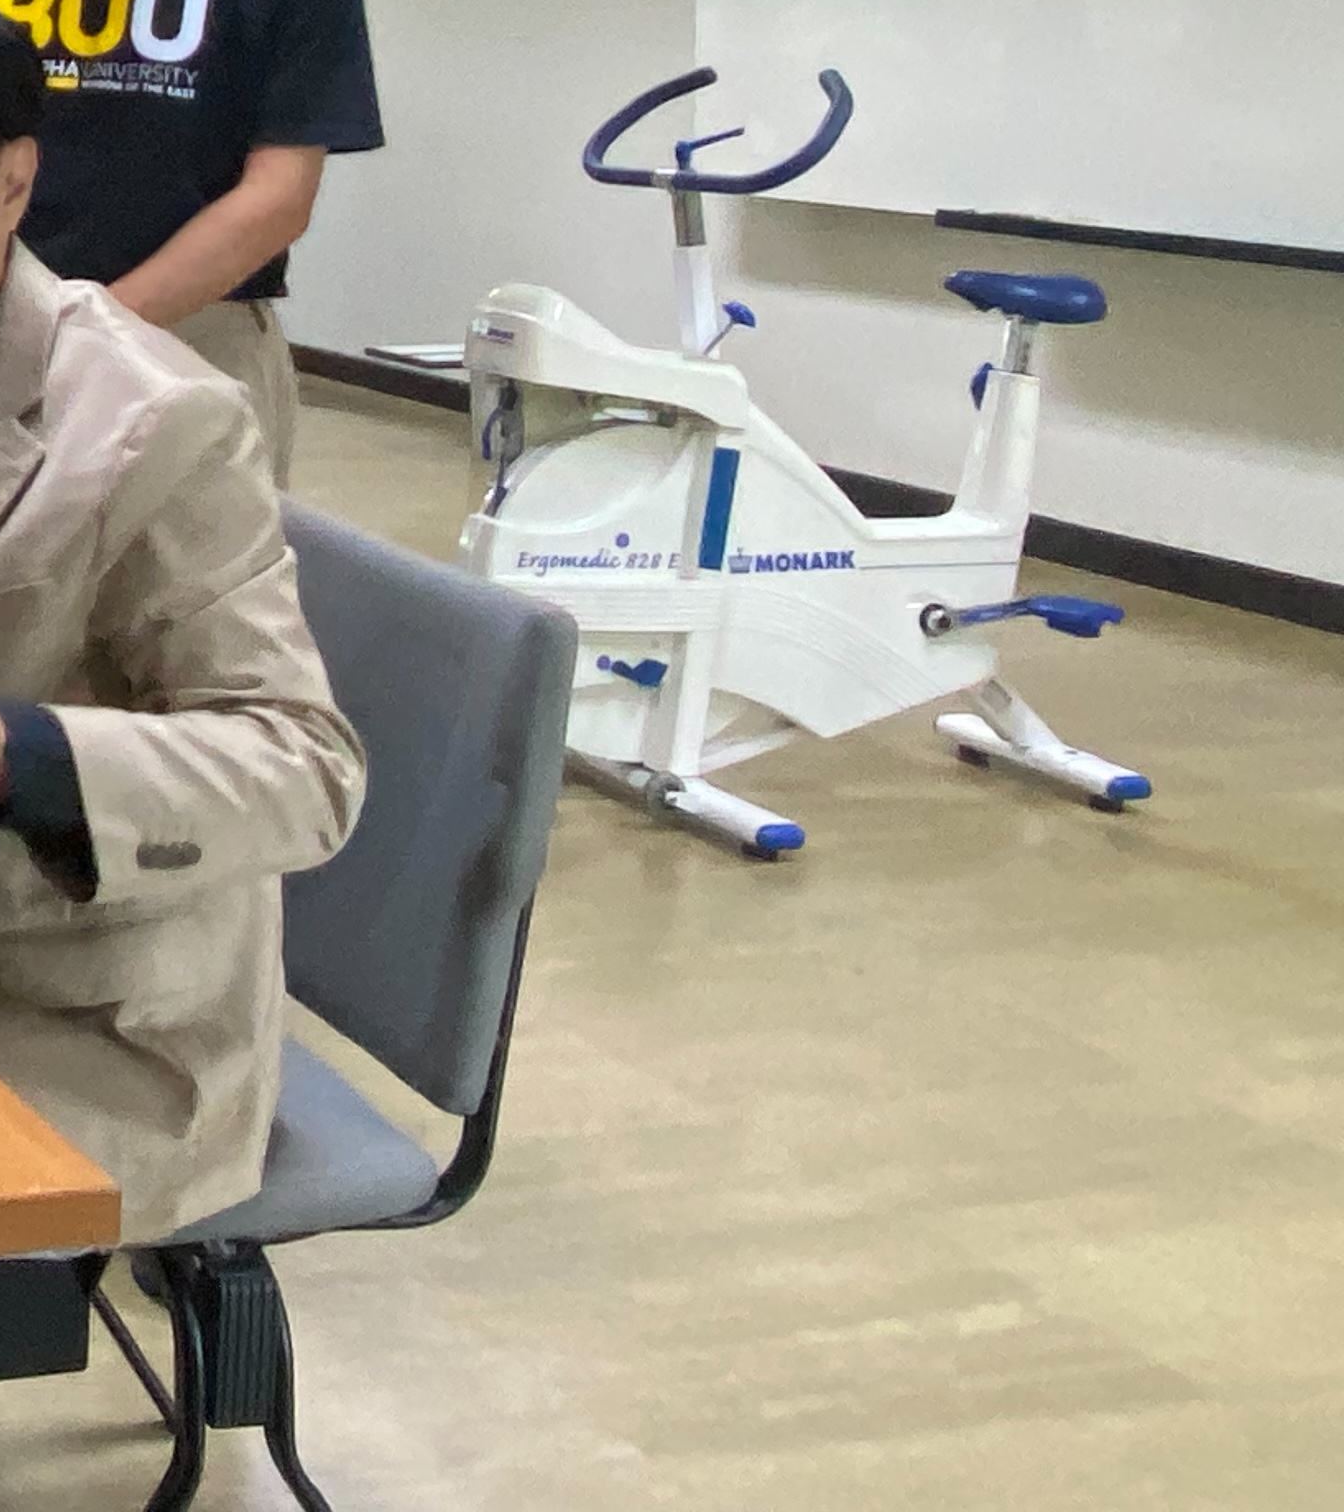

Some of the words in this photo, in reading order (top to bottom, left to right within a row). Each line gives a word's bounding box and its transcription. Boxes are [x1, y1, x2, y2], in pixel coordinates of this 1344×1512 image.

[80, 61, 199, 87] UNIVERSITY
[517, 547, 621, 577] Ergomedic
[623, 552, 662, 569] 828
[755, 550, 855, 572] MONARK
